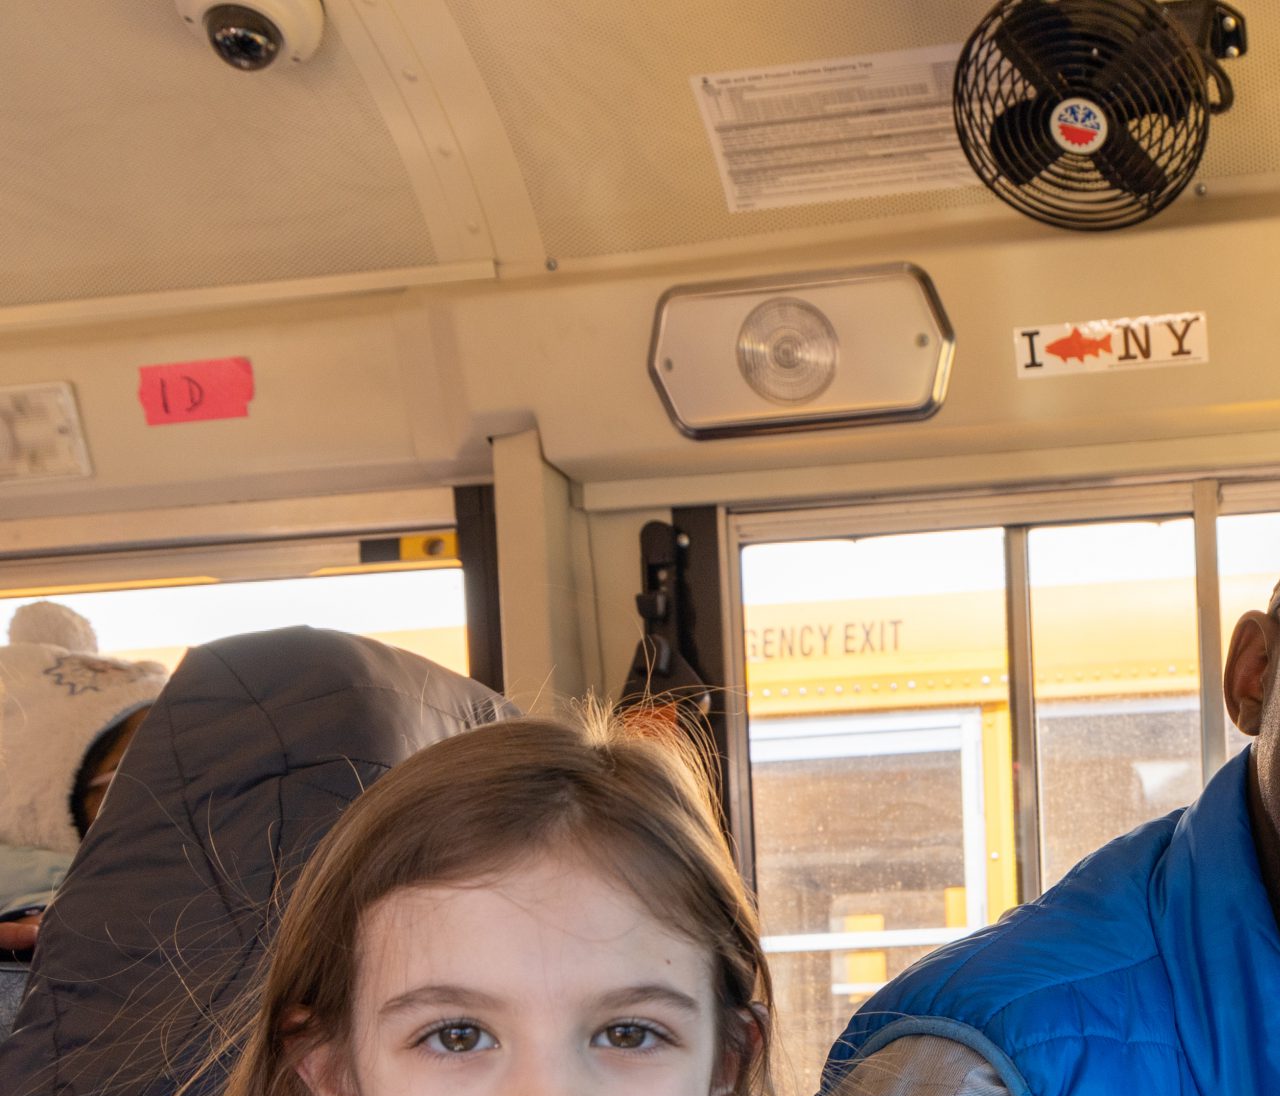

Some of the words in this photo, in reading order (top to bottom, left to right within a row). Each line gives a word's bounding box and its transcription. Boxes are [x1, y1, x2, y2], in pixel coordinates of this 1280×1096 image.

[1021, 330, 1043, 369] I
[1116, 316, 1200, 361] NY
[844, 618, 903, 654] EXIT
